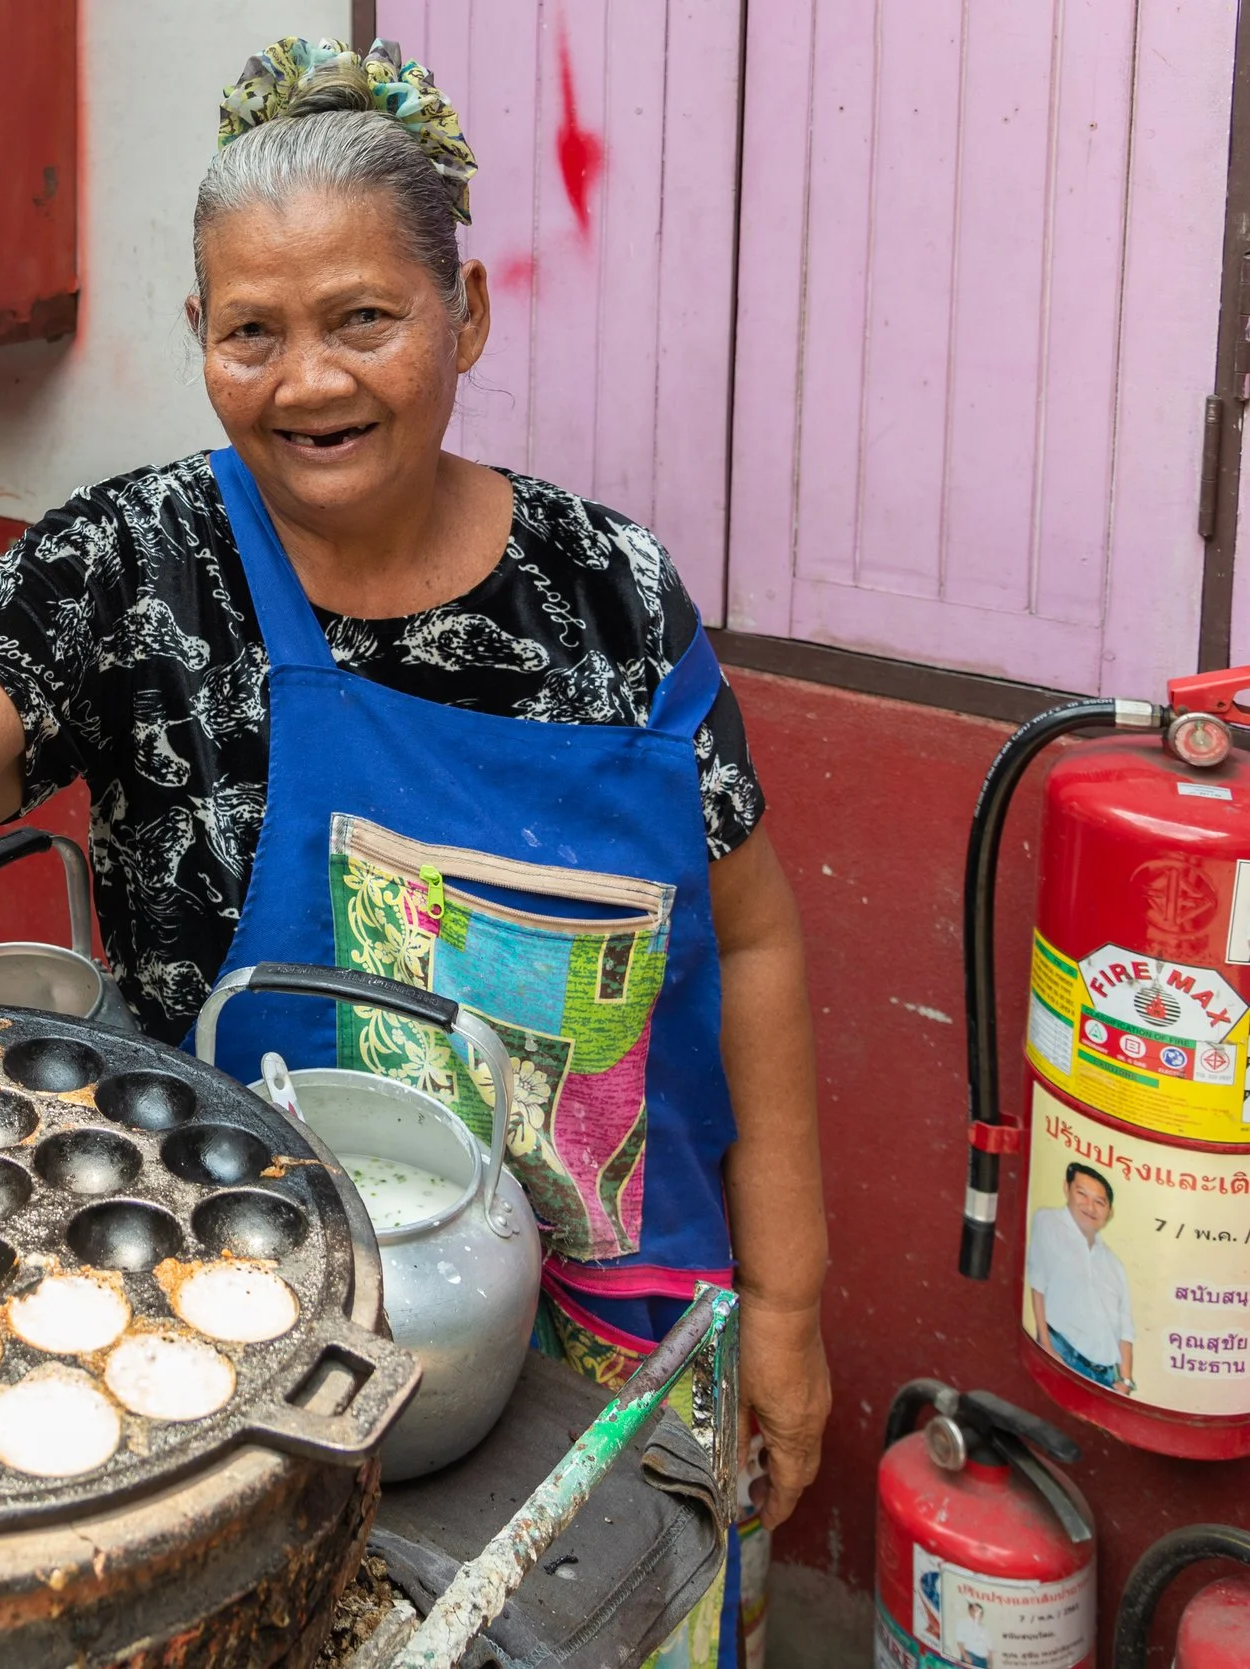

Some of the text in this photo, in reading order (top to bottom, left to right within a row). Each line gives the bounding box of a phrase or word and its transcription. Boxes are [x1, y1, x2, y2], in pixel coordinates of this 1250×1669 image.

[1089, 961, 1152, 999] FIRE
[1166, 969, 1232, 1028] MAX
[1045, 1115, 1250, 1195] ปรับปรุงและเติ
[1194, 1228, 1237, 1242] พ.ค.
[1169, 1353, 1246, 1374] ประธาน
